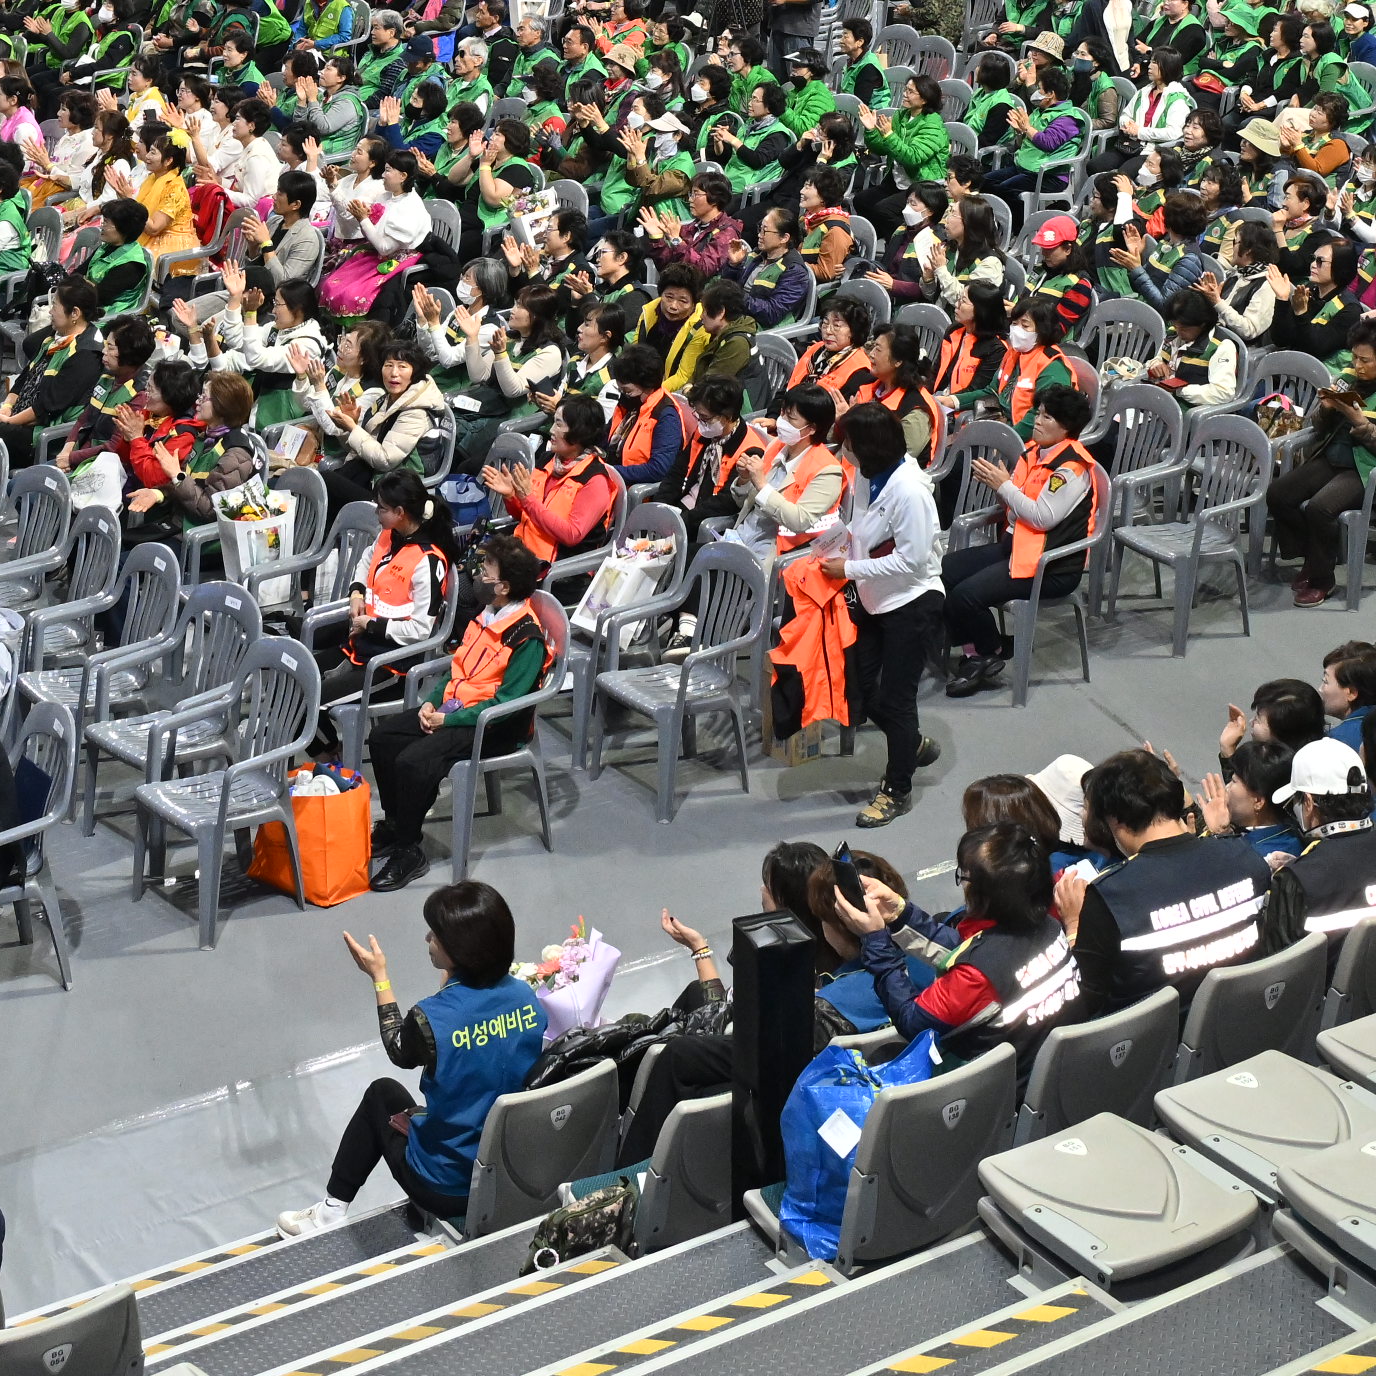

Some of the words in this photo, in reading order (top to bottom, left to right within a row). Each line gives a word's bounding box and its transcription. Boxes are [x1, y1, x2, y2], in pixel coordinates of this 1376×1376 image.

[452, 1004, 539, 1052] 여성예비군
[1115, 1044, 1126, 1053] BG
[949, 1104, 959, 1114] BG
[51, 1350, 64, 1359] BG
[49, 1357, 65, 1366] 054
